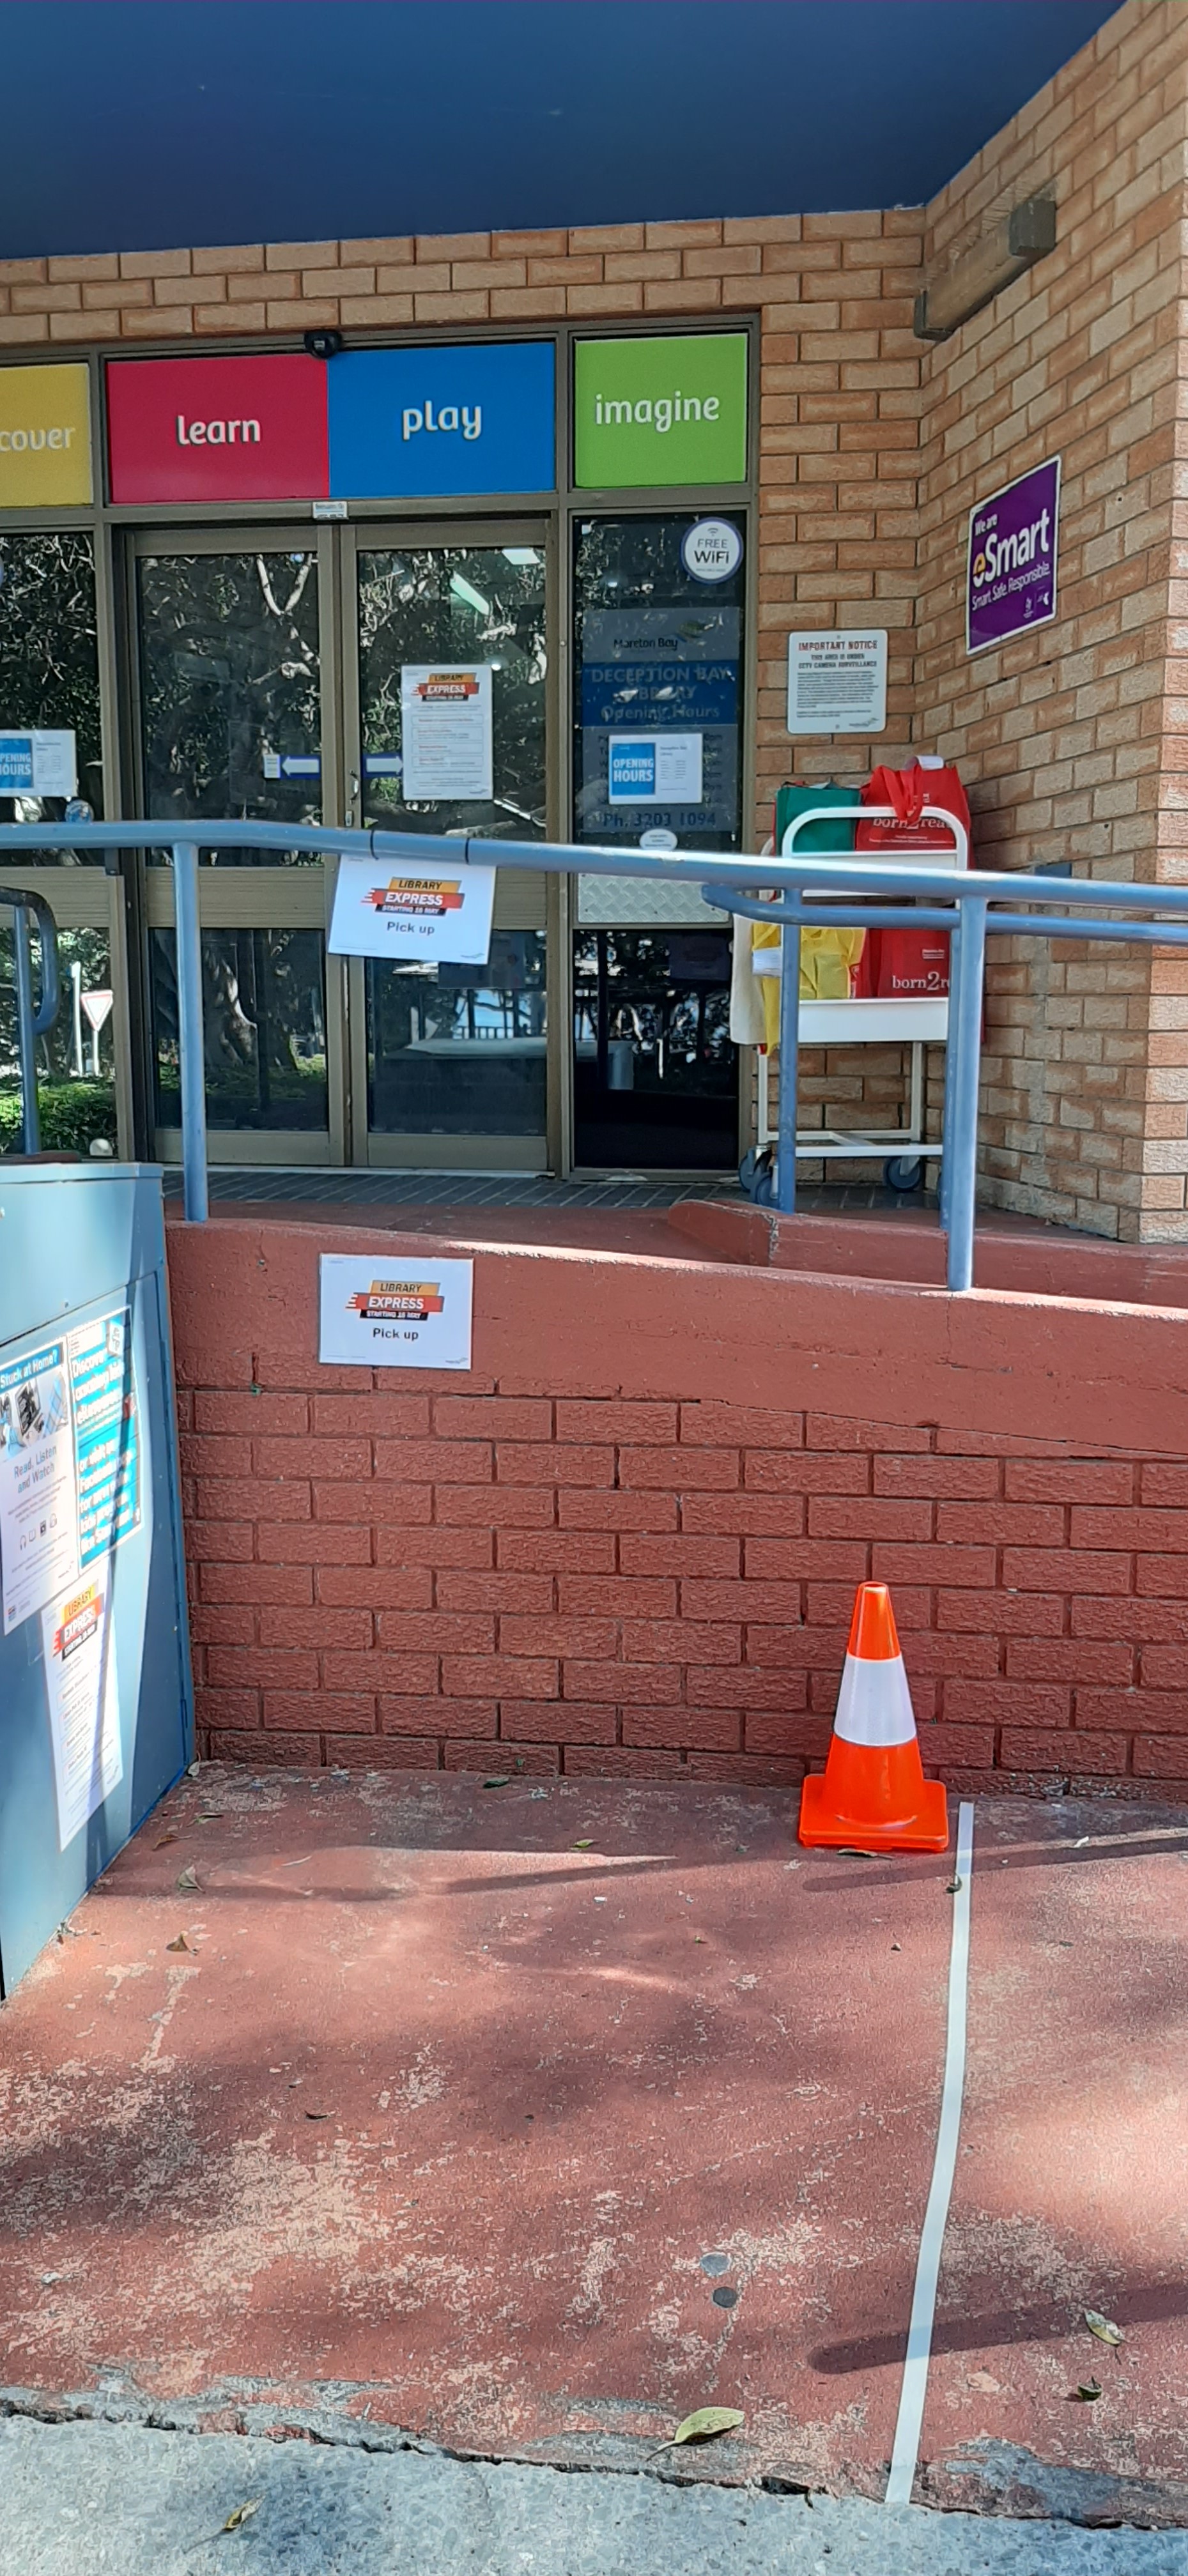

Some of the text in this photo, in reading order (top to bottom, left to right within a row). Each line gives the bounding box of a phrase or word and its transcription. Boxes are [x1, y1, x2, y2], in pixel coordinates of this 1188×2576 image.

[595, 390, 720, 433] imagine
[402, 400, 482, 441] play
[176, 415, 261, 445] learn
[0, 426, 75, 452] cover
[975, 513, 998, 537] We are
[697, 538, 728, 549] FREE
[973, 508, 1050, 588] eSmart
[694, 550, 729, 564] WiFi
[658, 637, 679, 652] Bay
[798, 640, 878, 651] IMPORTANT NOTICE
[591, 666, 730, 683] DECEPTION BAY
[426, 684, 467, 694] EXPRESS
[626, 686, 697, 700] BRRY
[601, 705, 720, 723] Opening Hours
[0, 763, 31, 776] OURS
[613, 758, 654, 769] OPENING
[613, 769, 654, 783] HOURS
[634, 812, 671, 825] 3203
[679, 811, 716, 825] 1094
[398, 879, 443, 890] LIBRARY
[385, 891, 444, 906] EXPRESS
[387, 921, 435, 936] Pick up
[380, 1282, 422, 1293] LIBRARY
[368, 1296, 424, 1310] EXPRESS
[373, 1327, 419, 1342] Pick up
[0, 1349, 58, 1389] Stuck at Home?
[36, 1445, 57, 1466] Listen
[18, 1461, 55, 1494] and Watch
